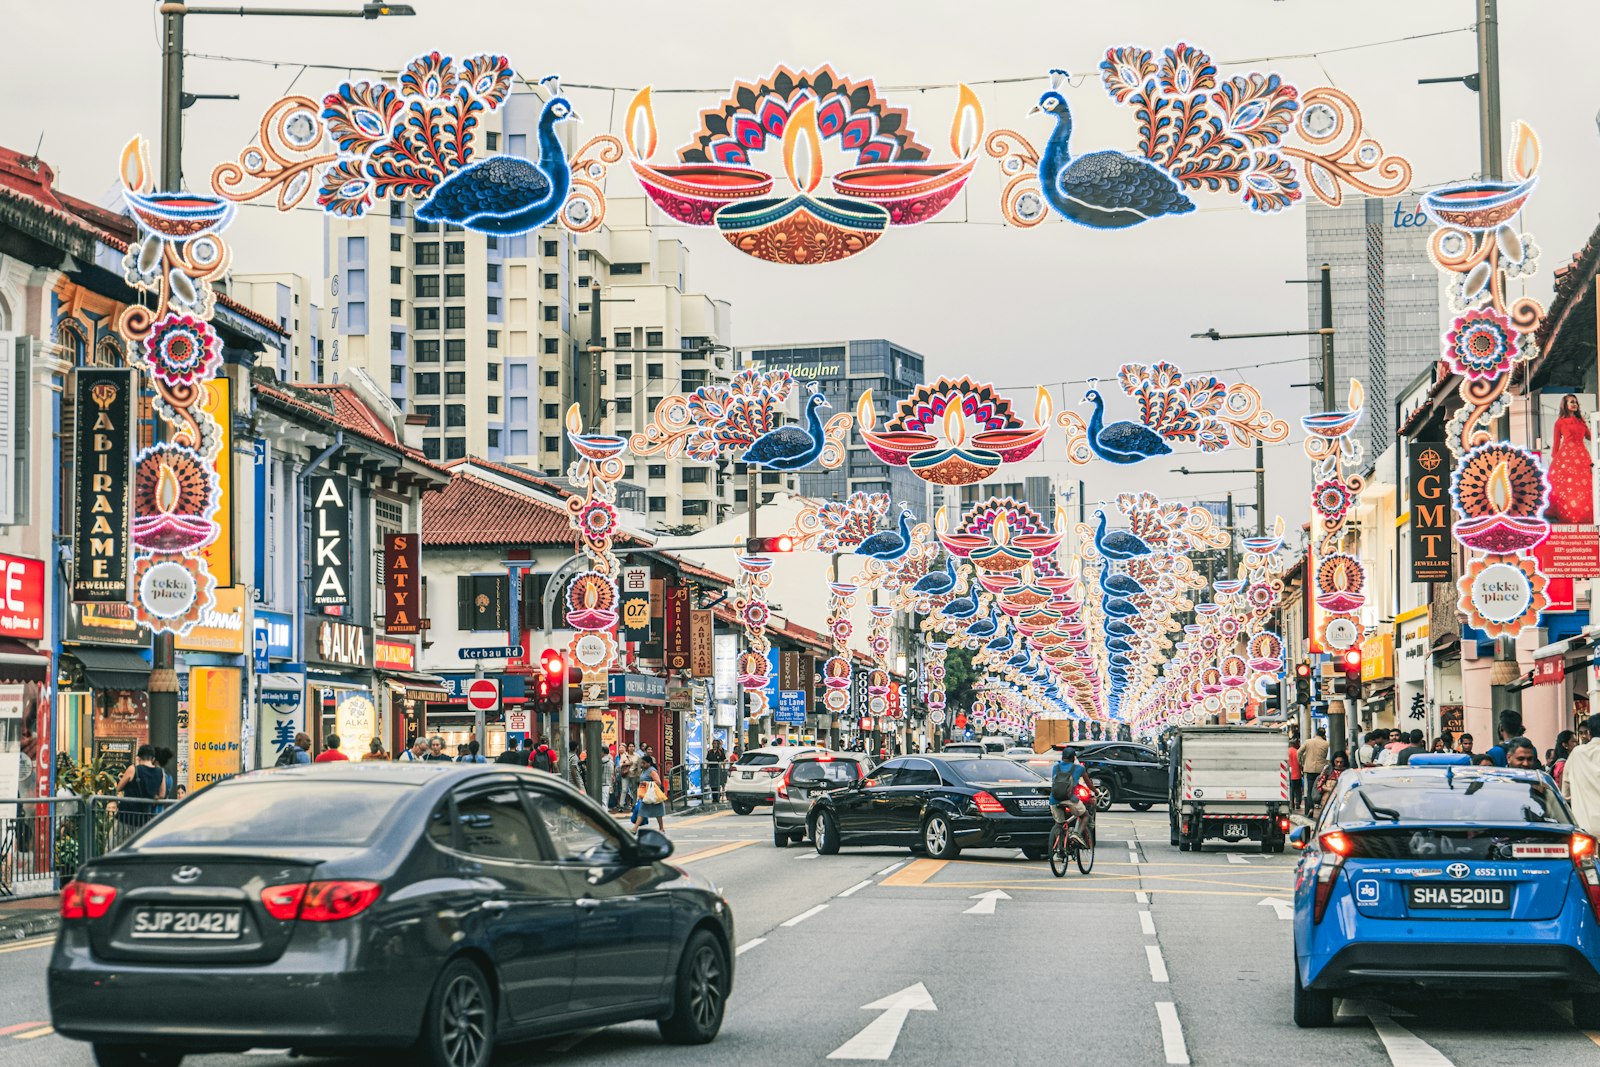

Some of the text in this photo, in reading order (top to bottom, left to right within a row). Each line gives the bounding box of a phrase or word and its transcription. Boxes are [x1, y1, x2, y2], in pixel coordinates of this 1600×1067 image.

[90, 411, 115, 579] ABIRAAME
[1415, 474, 1447, 559] GMT
[314, 478, 345, 597] ALKA
[0, 560, 26, 613] E
[75, 581, 125, 590] JEWELLERS
[152, 579, 188, 590] tekka
[393, 537, 409, 624] SATYA
[1482, 582, 1519, 592] tekka
[151, 589, 188, 600] place
[1481, 592, 1519, 604] place
[331, 622, 366, 666] ALKA
[463, 647, 518, 659] Kerbau Rd
[673, 658, 683, 666] 85
[789, 698, 804, 706] Lane
[194, 742, 239, 751] Old Gold For
[665, 725, 673, 760] TOP CASH
[1475, 868, 1496, 876] 6552
[1361, 884, 1375, 897] zig
[1414, 888, 1504, 903] SHA5201D
